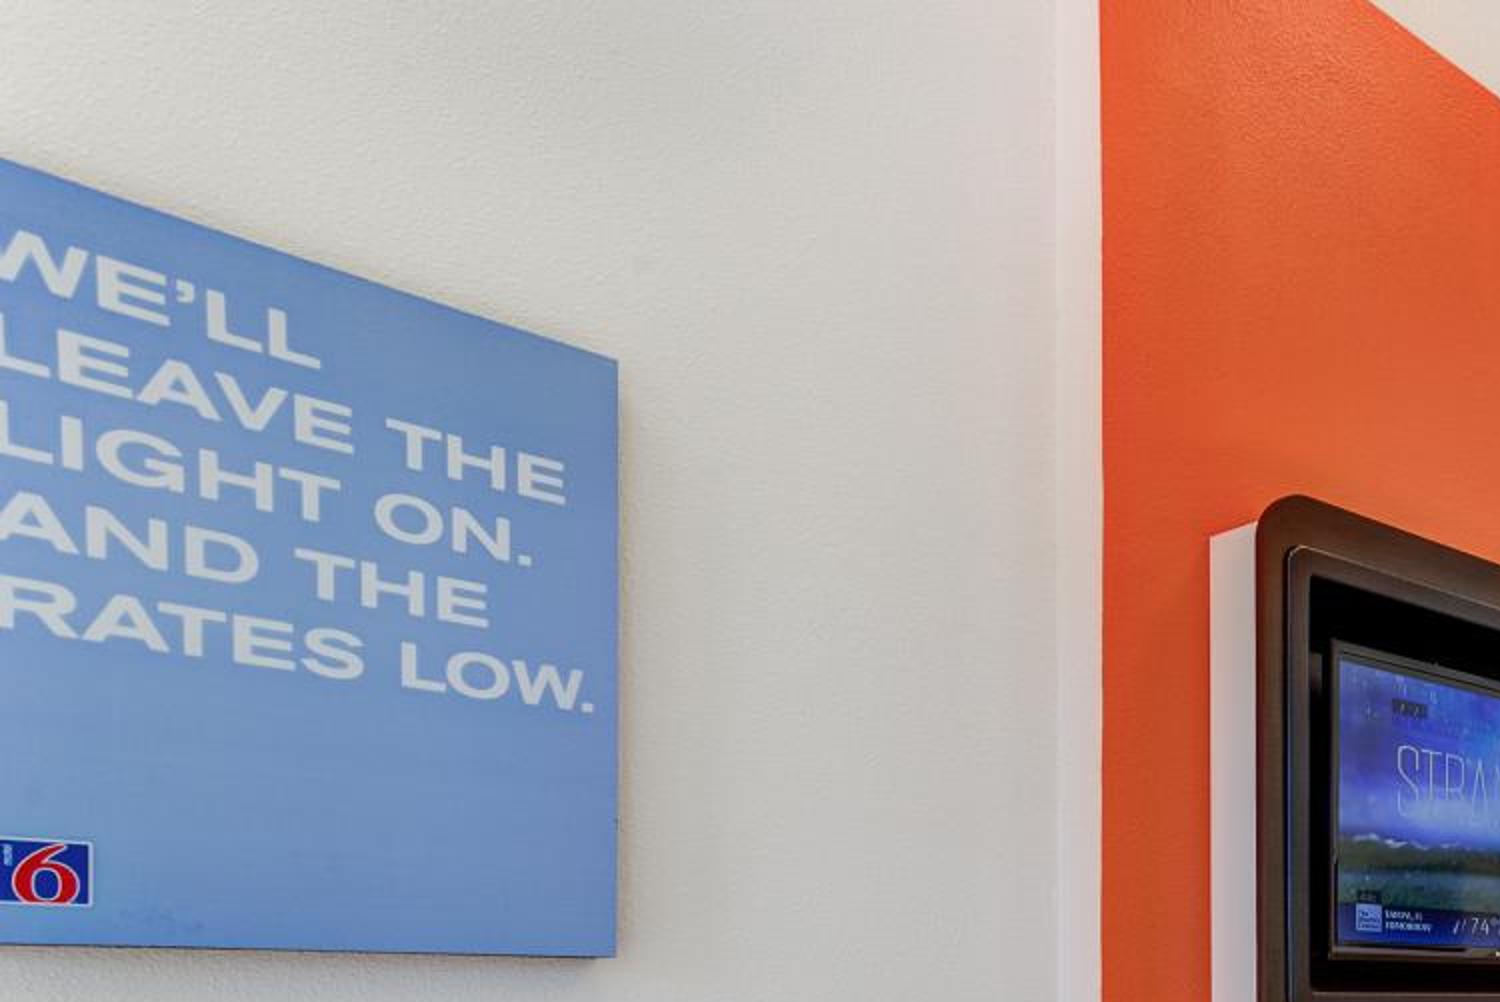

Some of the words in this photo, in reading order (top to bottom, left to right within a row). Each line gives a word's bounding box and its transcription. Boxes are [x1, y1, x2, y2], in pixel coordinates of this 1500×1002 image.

[0, 312, 354, 455] LEAVE
[386, 418, 566, 506] THE
[0, 398, 341, 522] LIGHT
[373, 493, 533, 567] ON.
[0, 491, 259, 584] AND
[294, 548, 489, 629] THE
[0, 573, 365, 680] RATES
[400, 641, 594, 713] LOW.
[11, 842, 81, 906] 6
